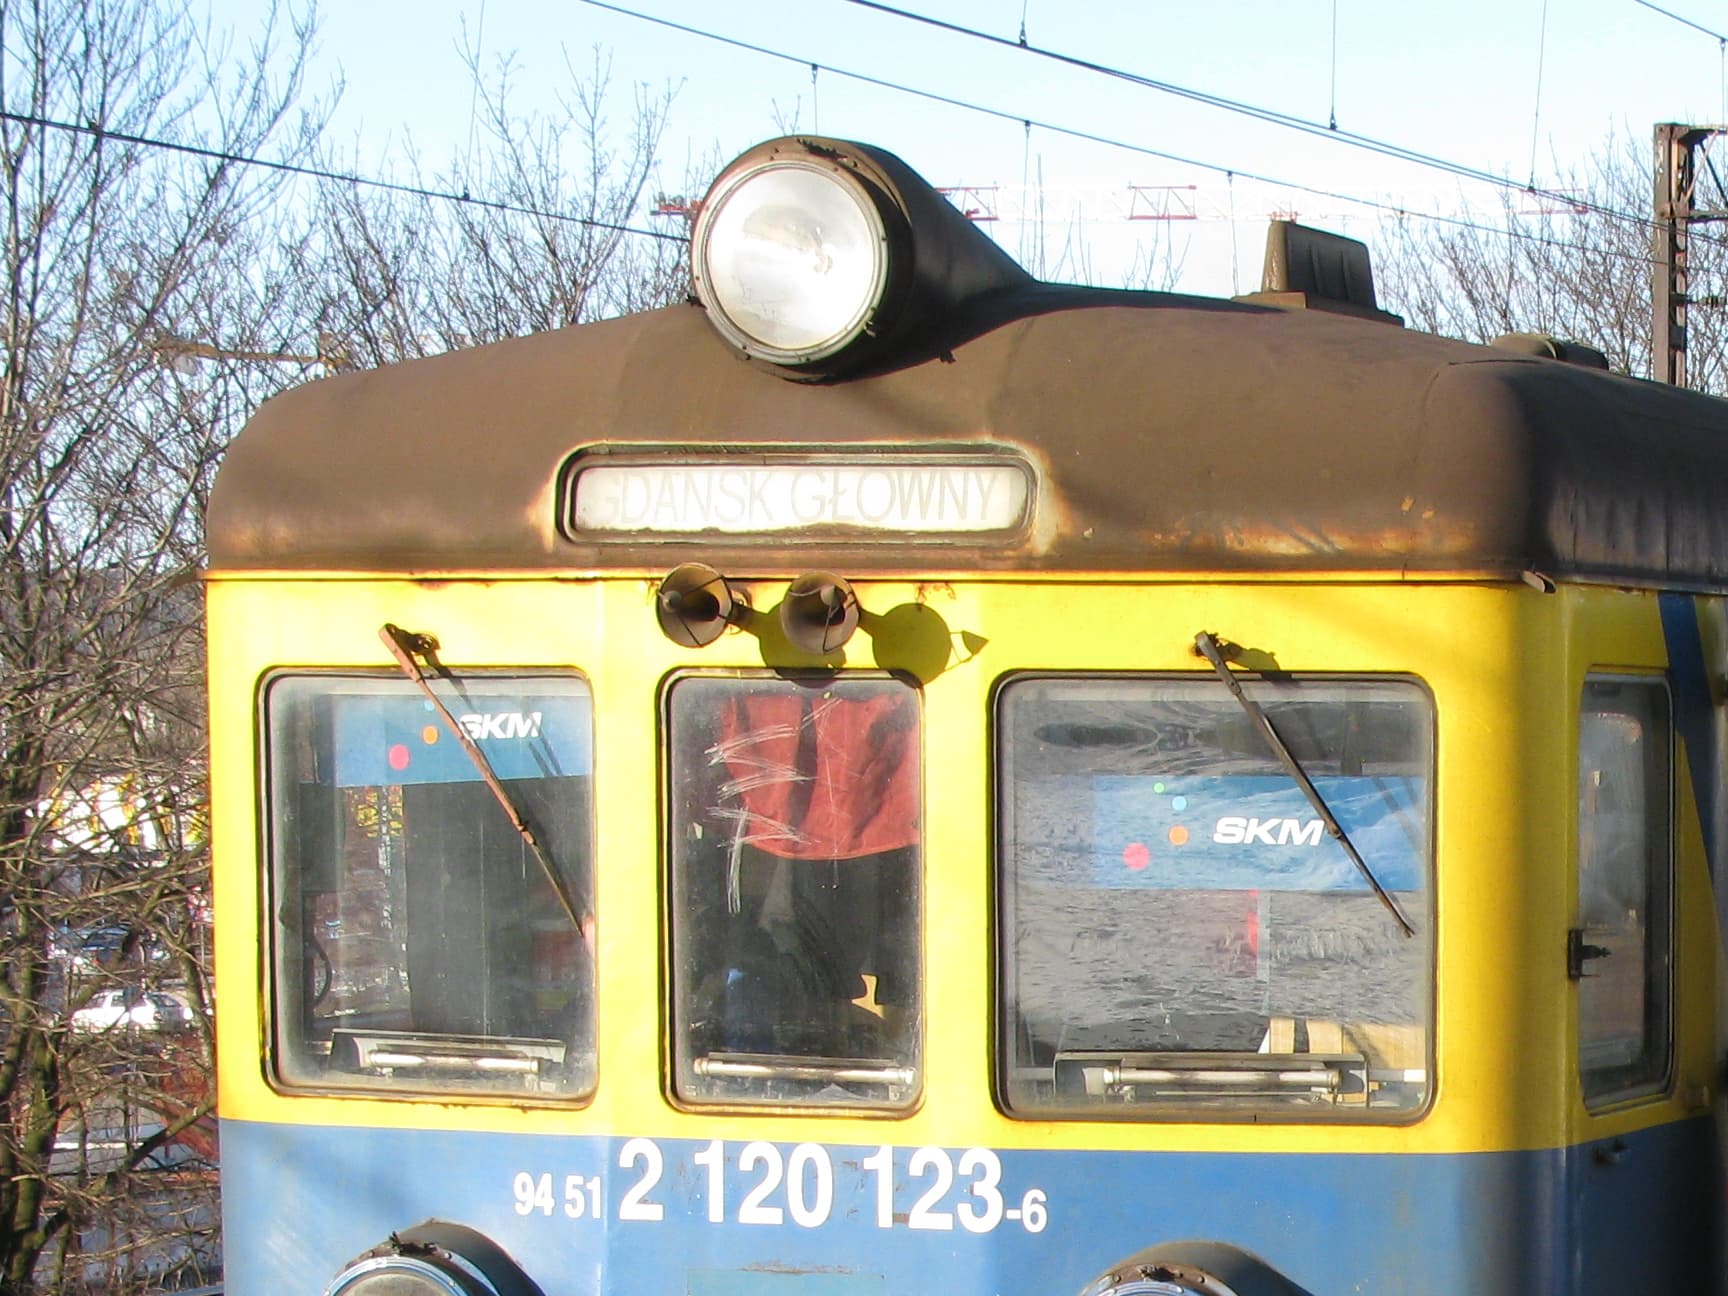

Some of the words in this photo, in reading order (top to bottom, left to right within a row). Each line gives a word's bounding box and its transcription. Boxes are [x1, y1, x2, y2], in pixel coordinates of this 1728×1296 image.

[459, 712, 542, 739] SKM
[1212, 816, 1325, 846] SKM
[513, 1171, 555, 1216] 94
[564, 1174, 601, 1219] 51
[618, 1137, 664, 1222] 2
[694, 1140, 834, 1228] 120
